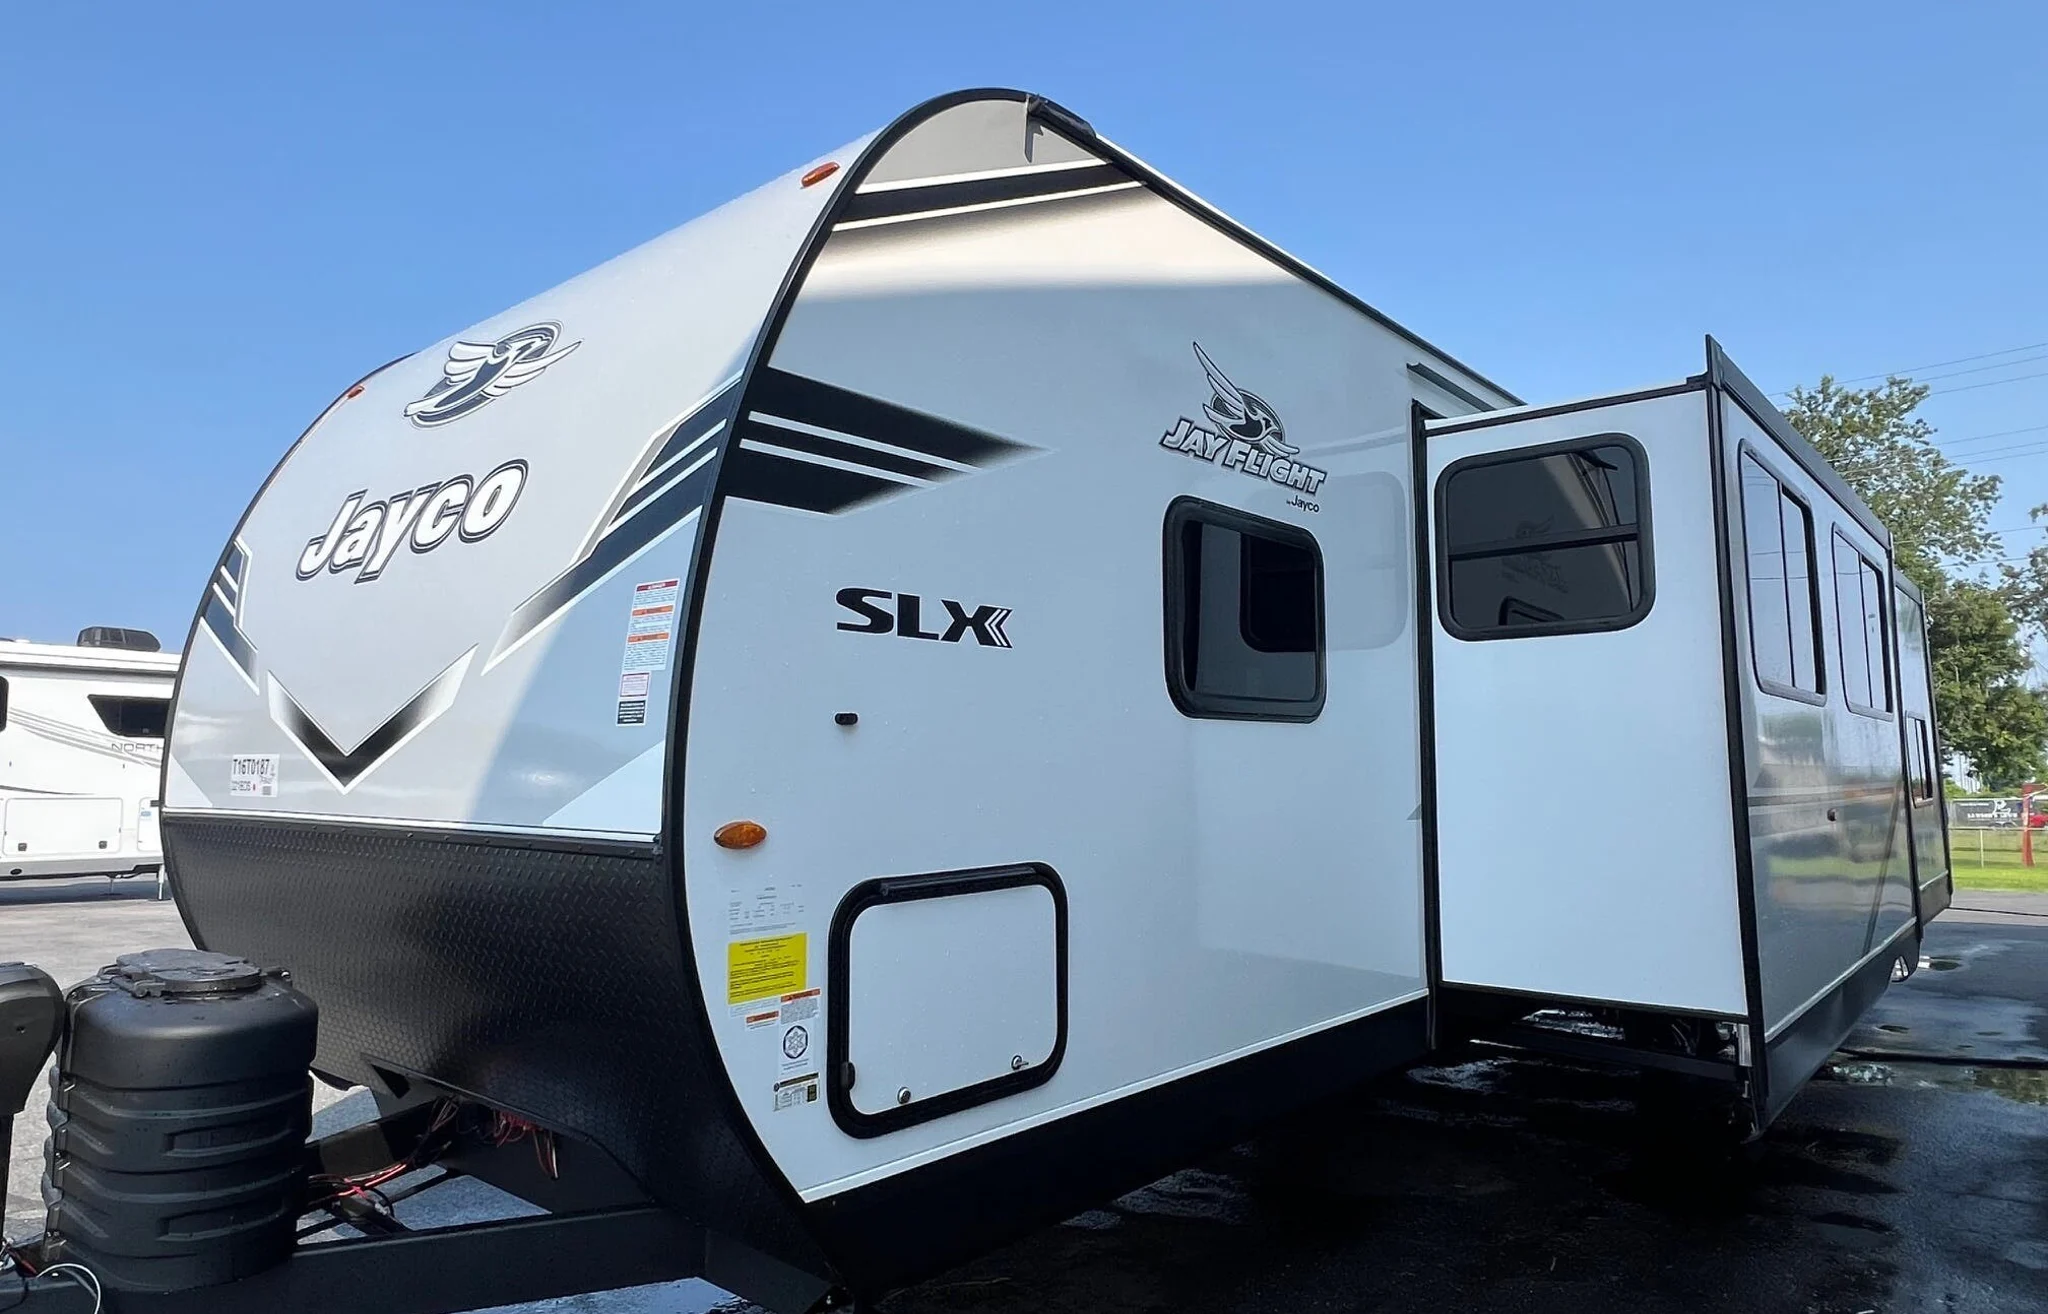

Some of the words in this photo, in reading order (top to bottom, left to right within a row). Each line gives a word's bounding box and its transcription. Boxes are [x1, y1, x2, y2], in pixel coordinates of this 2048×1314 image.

[1160, 417, 1226, 463] JAY
[1224, 440, 1327, 494] FLIGHT
[296, 458, 530, 584] Jayco
[1291, 494, 1320, 513] Jayco
[835, 587, 1013, 649] SLX
